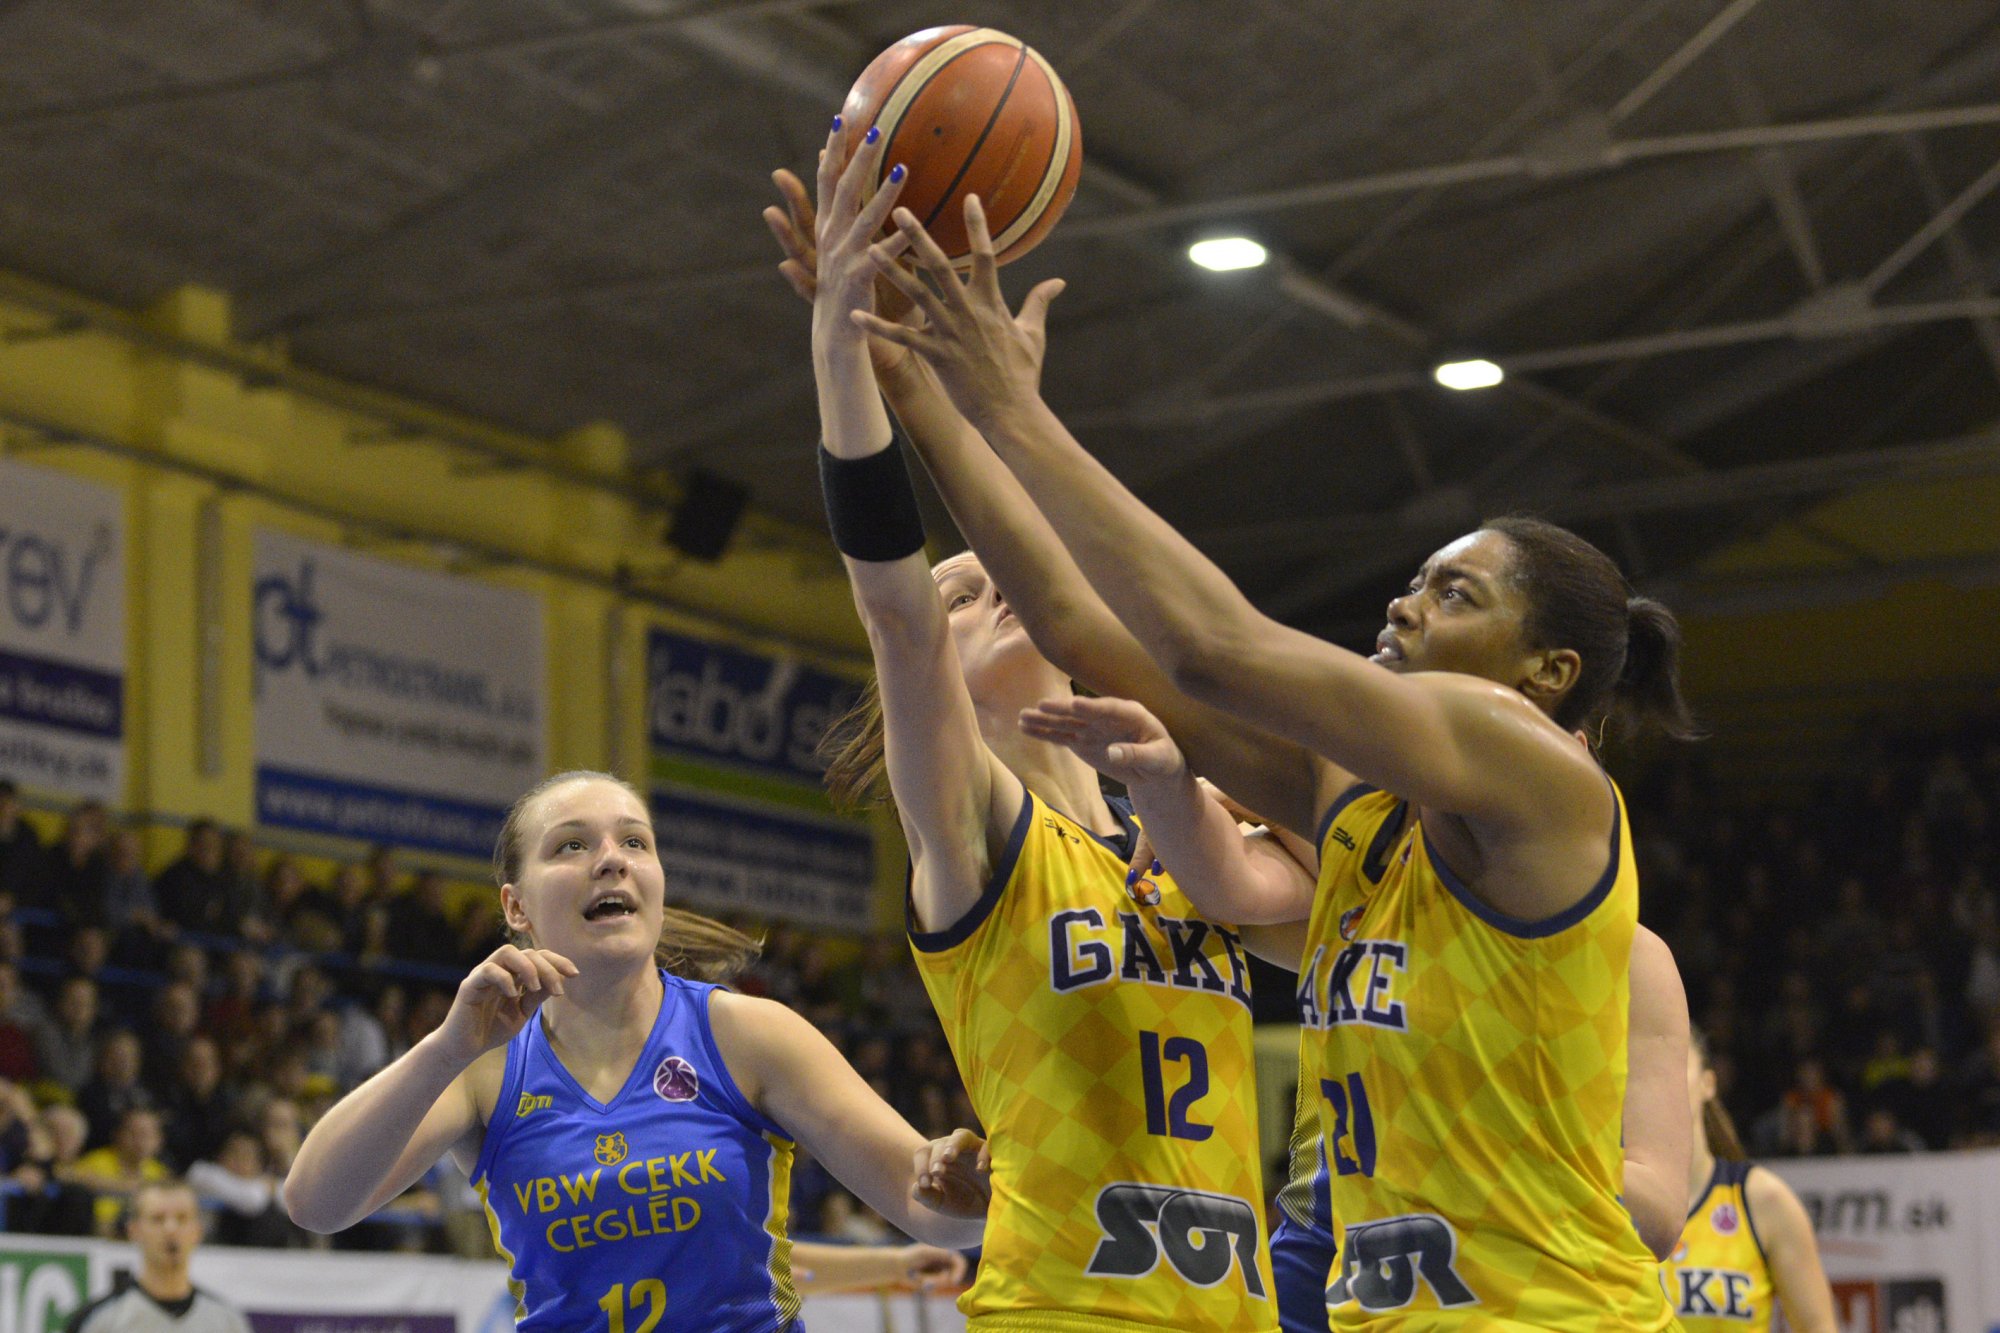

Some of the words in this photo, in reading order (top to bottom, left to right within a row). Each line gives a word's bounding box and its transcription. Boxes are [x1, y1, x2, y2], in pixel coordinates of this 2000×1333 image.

[1296, 938, 1409, 1034] AKE
[1138, 1029, 1215, 1143] 12
[1319, 1071, 1377, 1178] 21
[513, 1168, 603, 1216] VBW
[617, 1148, 727, 1197] CEKK
[598, 1277, 667, 1333] 12
